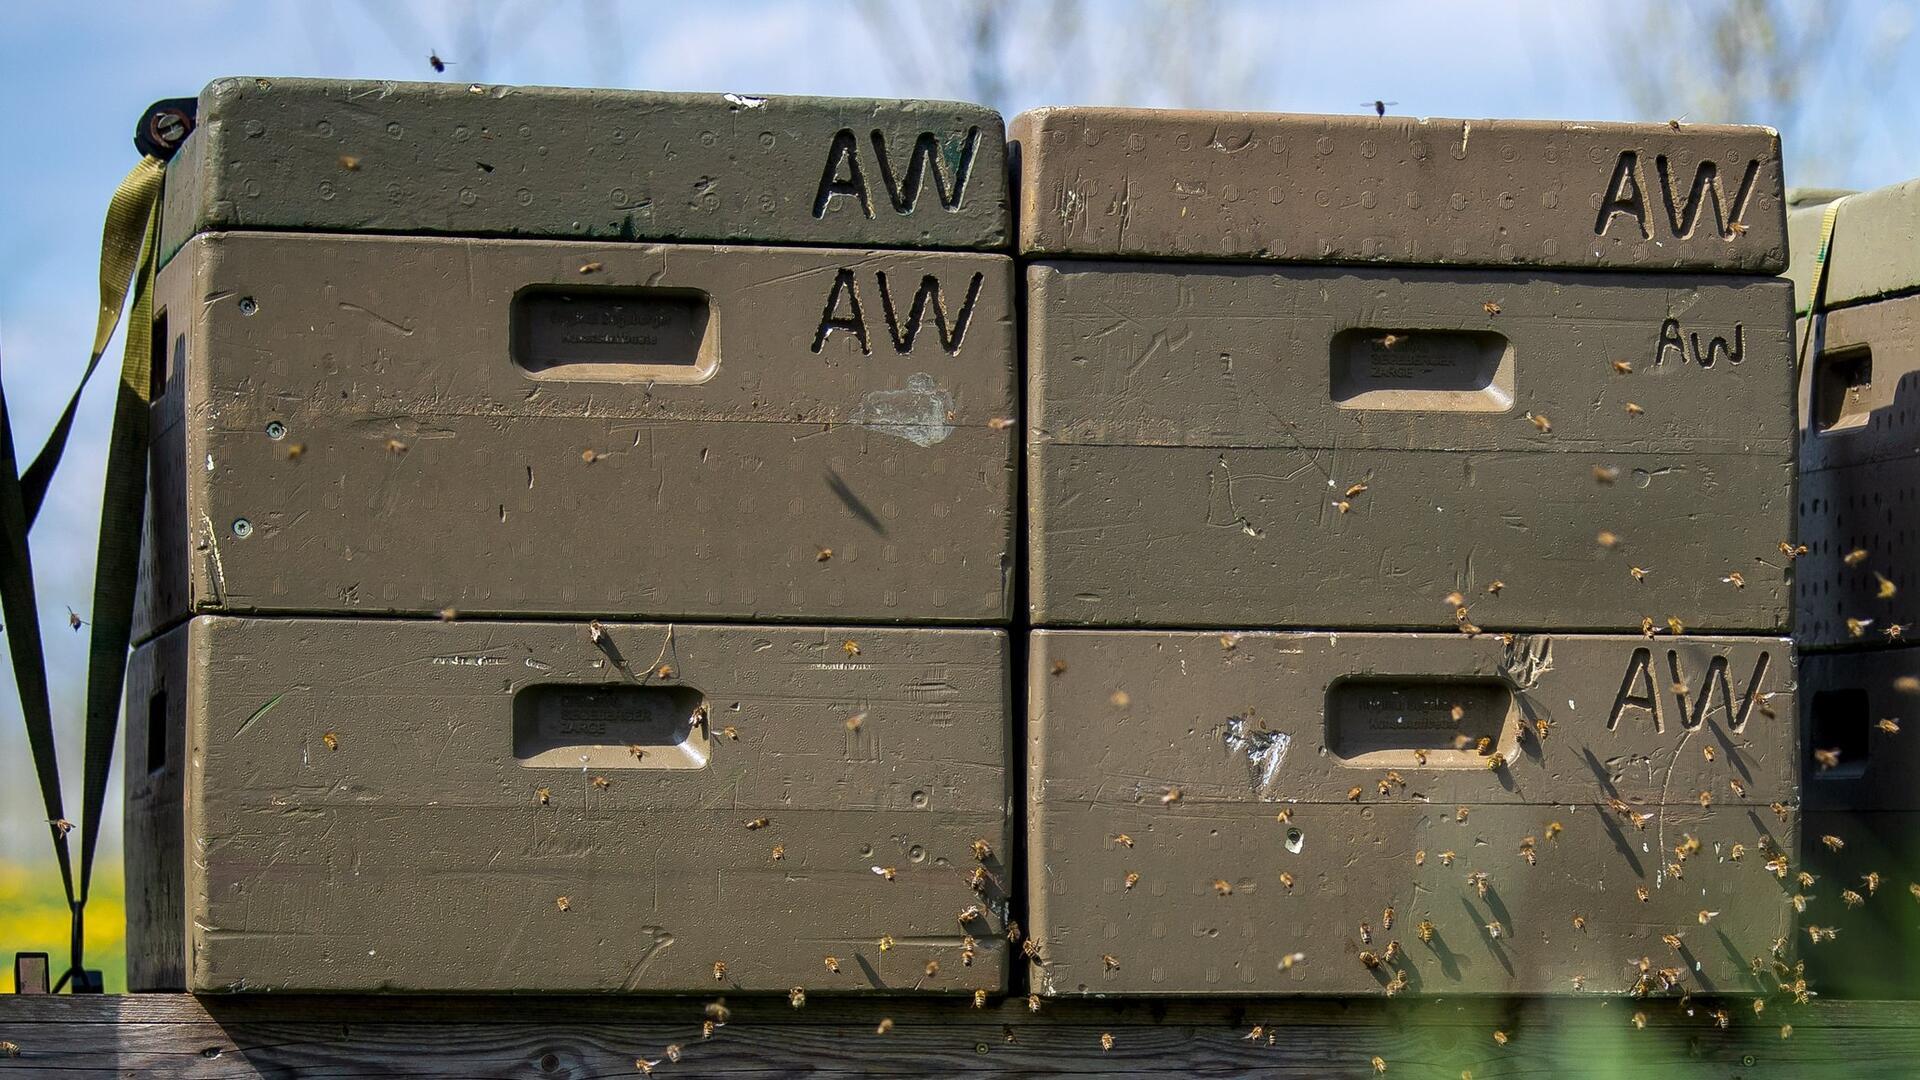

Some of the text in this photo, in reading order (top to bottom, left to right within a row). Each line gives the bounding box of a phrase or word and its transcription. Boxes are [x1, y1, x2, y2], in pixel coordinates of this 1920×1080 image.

[811, 126, 982, 220] AW
[1594, 150, 1760, 242] AW
[811, 267, 984, 357] AW
[1606, 647, 1771, 734] AW
